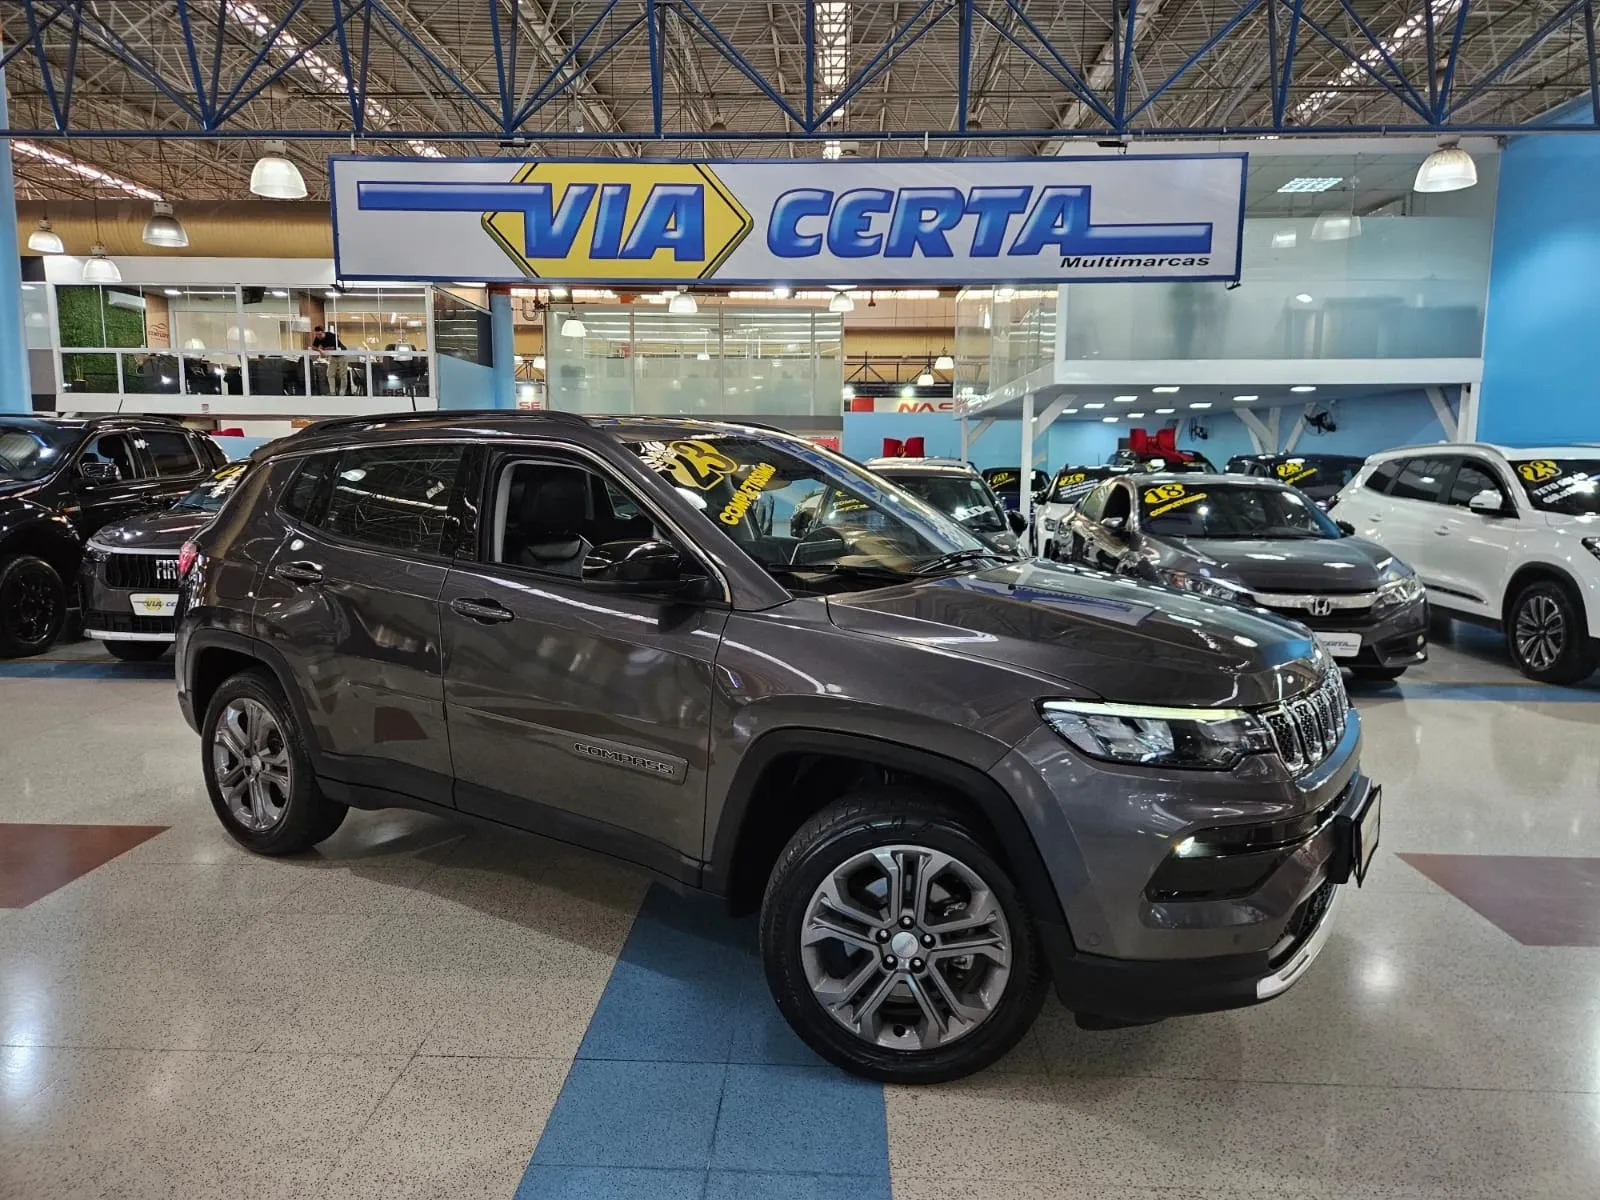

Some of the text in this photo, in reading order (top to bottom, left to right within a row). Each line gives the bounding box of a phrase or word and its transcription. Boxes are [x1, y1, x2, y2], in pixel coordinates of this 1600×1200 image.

[521, 183, 1092, 261] VIA CERTA
[1060, 256, 1210, 268] Multimarcas
[1517, 459, 1562, 482] 23
[1144, 484, 1185, 503] 18
[574, 742, 675, 776] COMPASS
